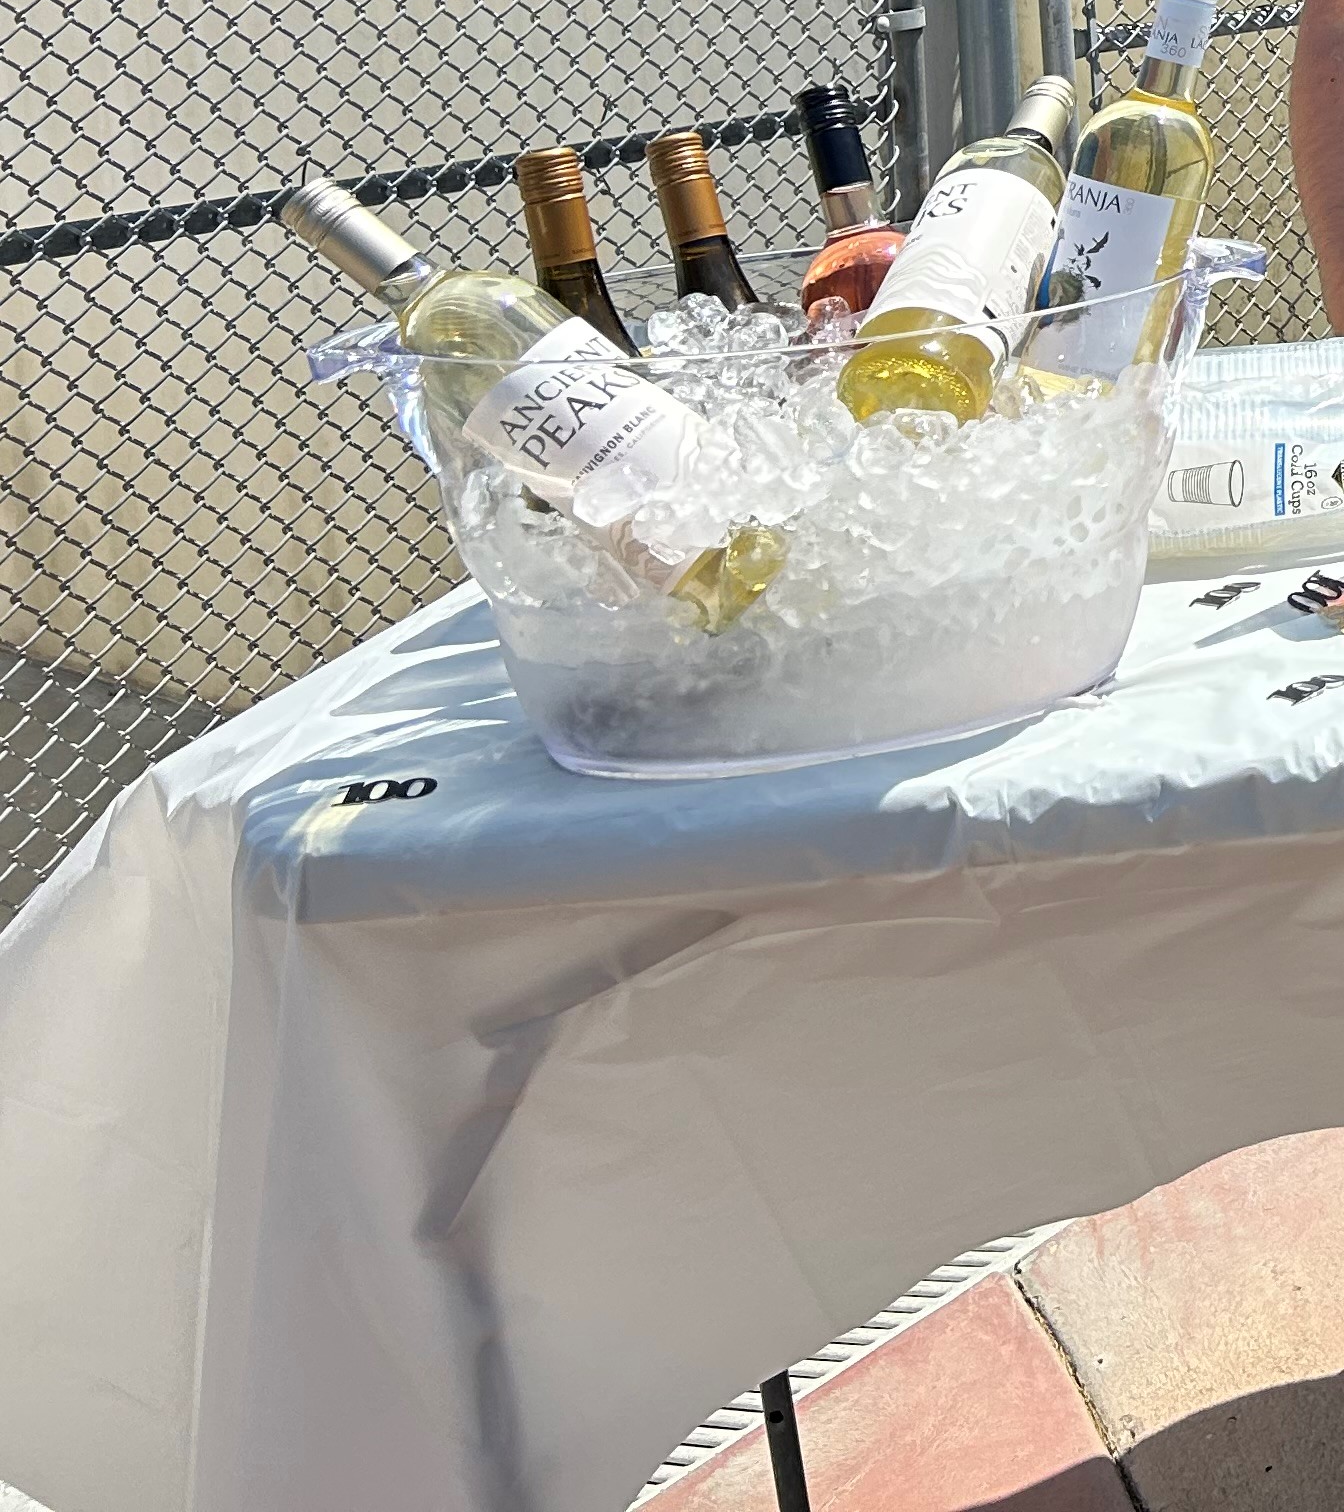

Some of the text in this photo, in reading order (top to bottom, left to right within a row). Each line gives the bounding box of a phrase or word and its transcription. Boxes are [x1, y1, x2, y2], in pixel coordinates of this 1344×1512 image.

[1160, 44, 1187, 58] 360
[499, 336, 614, 447] ANCIENT
[519, 354, 641, 471] PEAKS
[624, 405, 658, 434] BLANC
[1287, 444, 1304, 515] Cold Cups
[1304, 463, 1318, 496] 16 oz
[331, 776, 438, 807] 100
